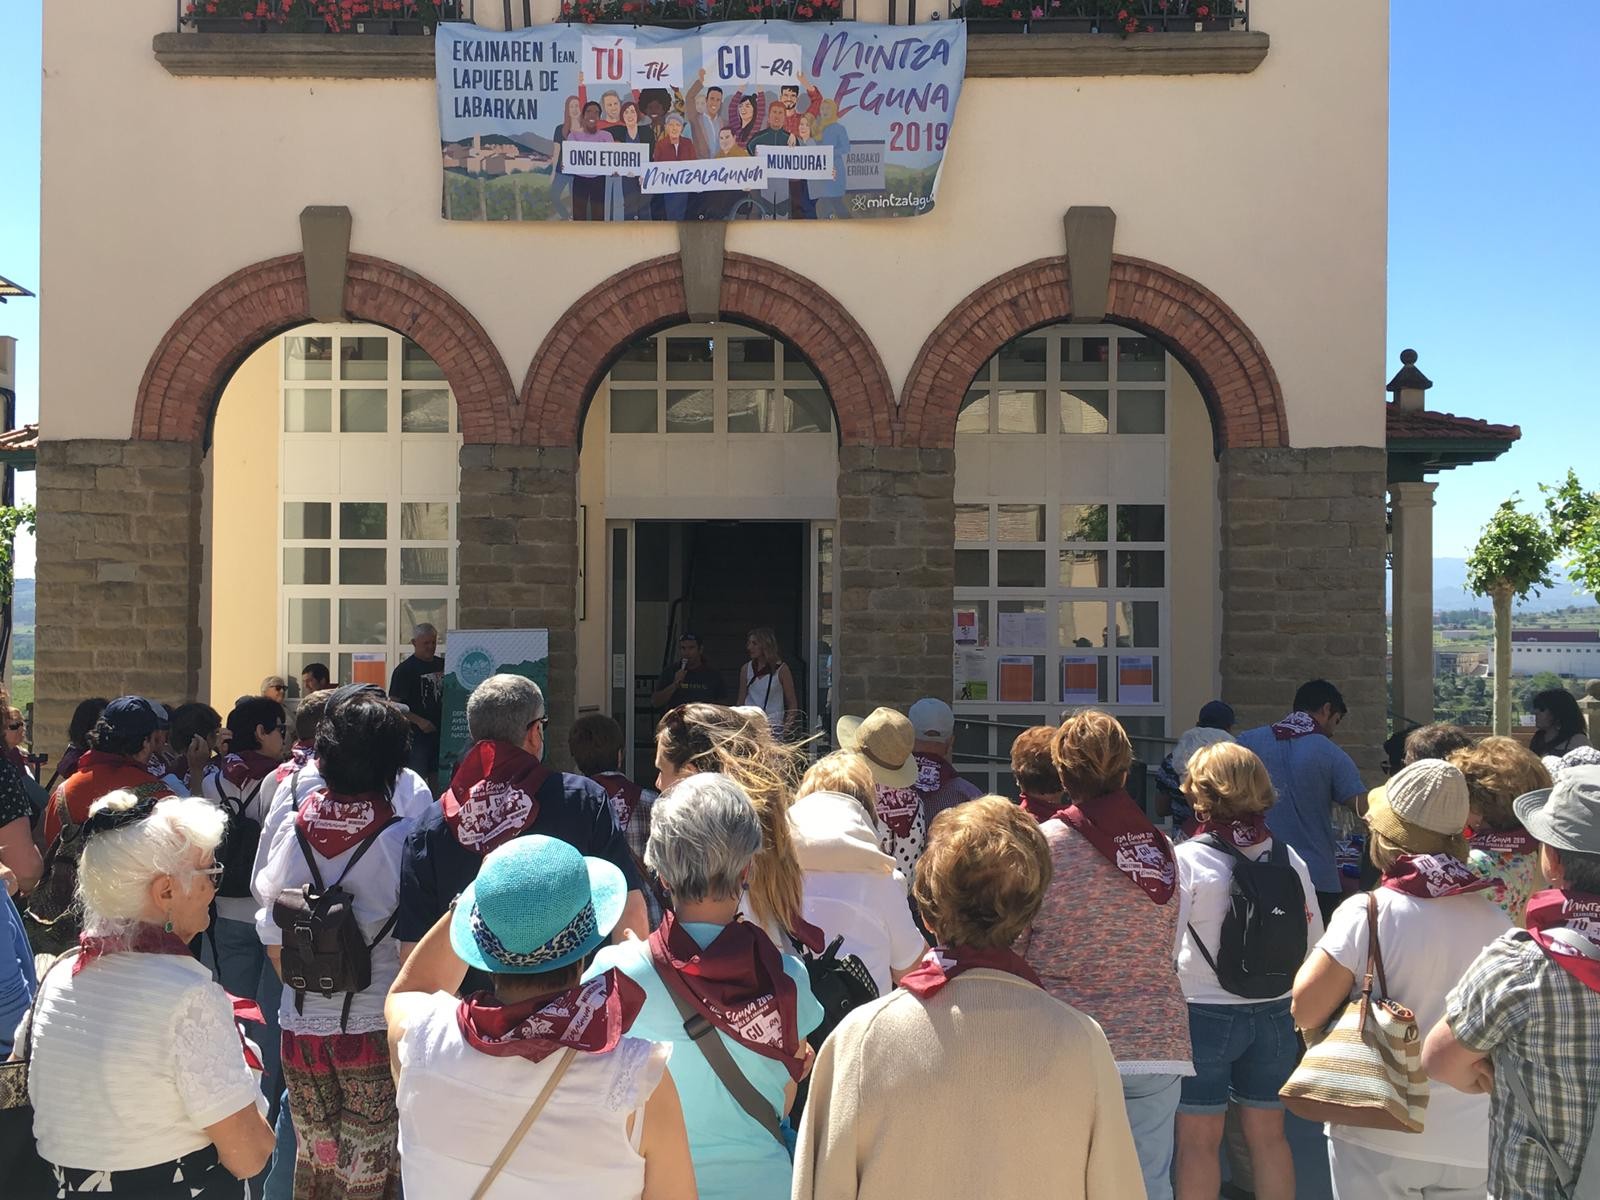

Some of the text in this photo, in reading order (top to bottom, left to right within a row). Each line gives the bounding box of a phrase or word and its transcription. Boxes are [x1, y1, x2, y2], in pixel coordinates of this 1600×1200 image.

[453, 40, 543, 63] EKAINAREN
[592, 38, 624, 80] TÚ
[717, 45, 750, 80] GU
[453, 68, 559, 92] LAPUEBLA DE
[454, 96, 538, 120] LABARKAN
[890, 122, 950, 152] 2019
[569, 149, 641, 168] ONGI ETORRI
[767, 153, 827, 171] MUNDURA!
[746, 1022, 764, 1040] GU
